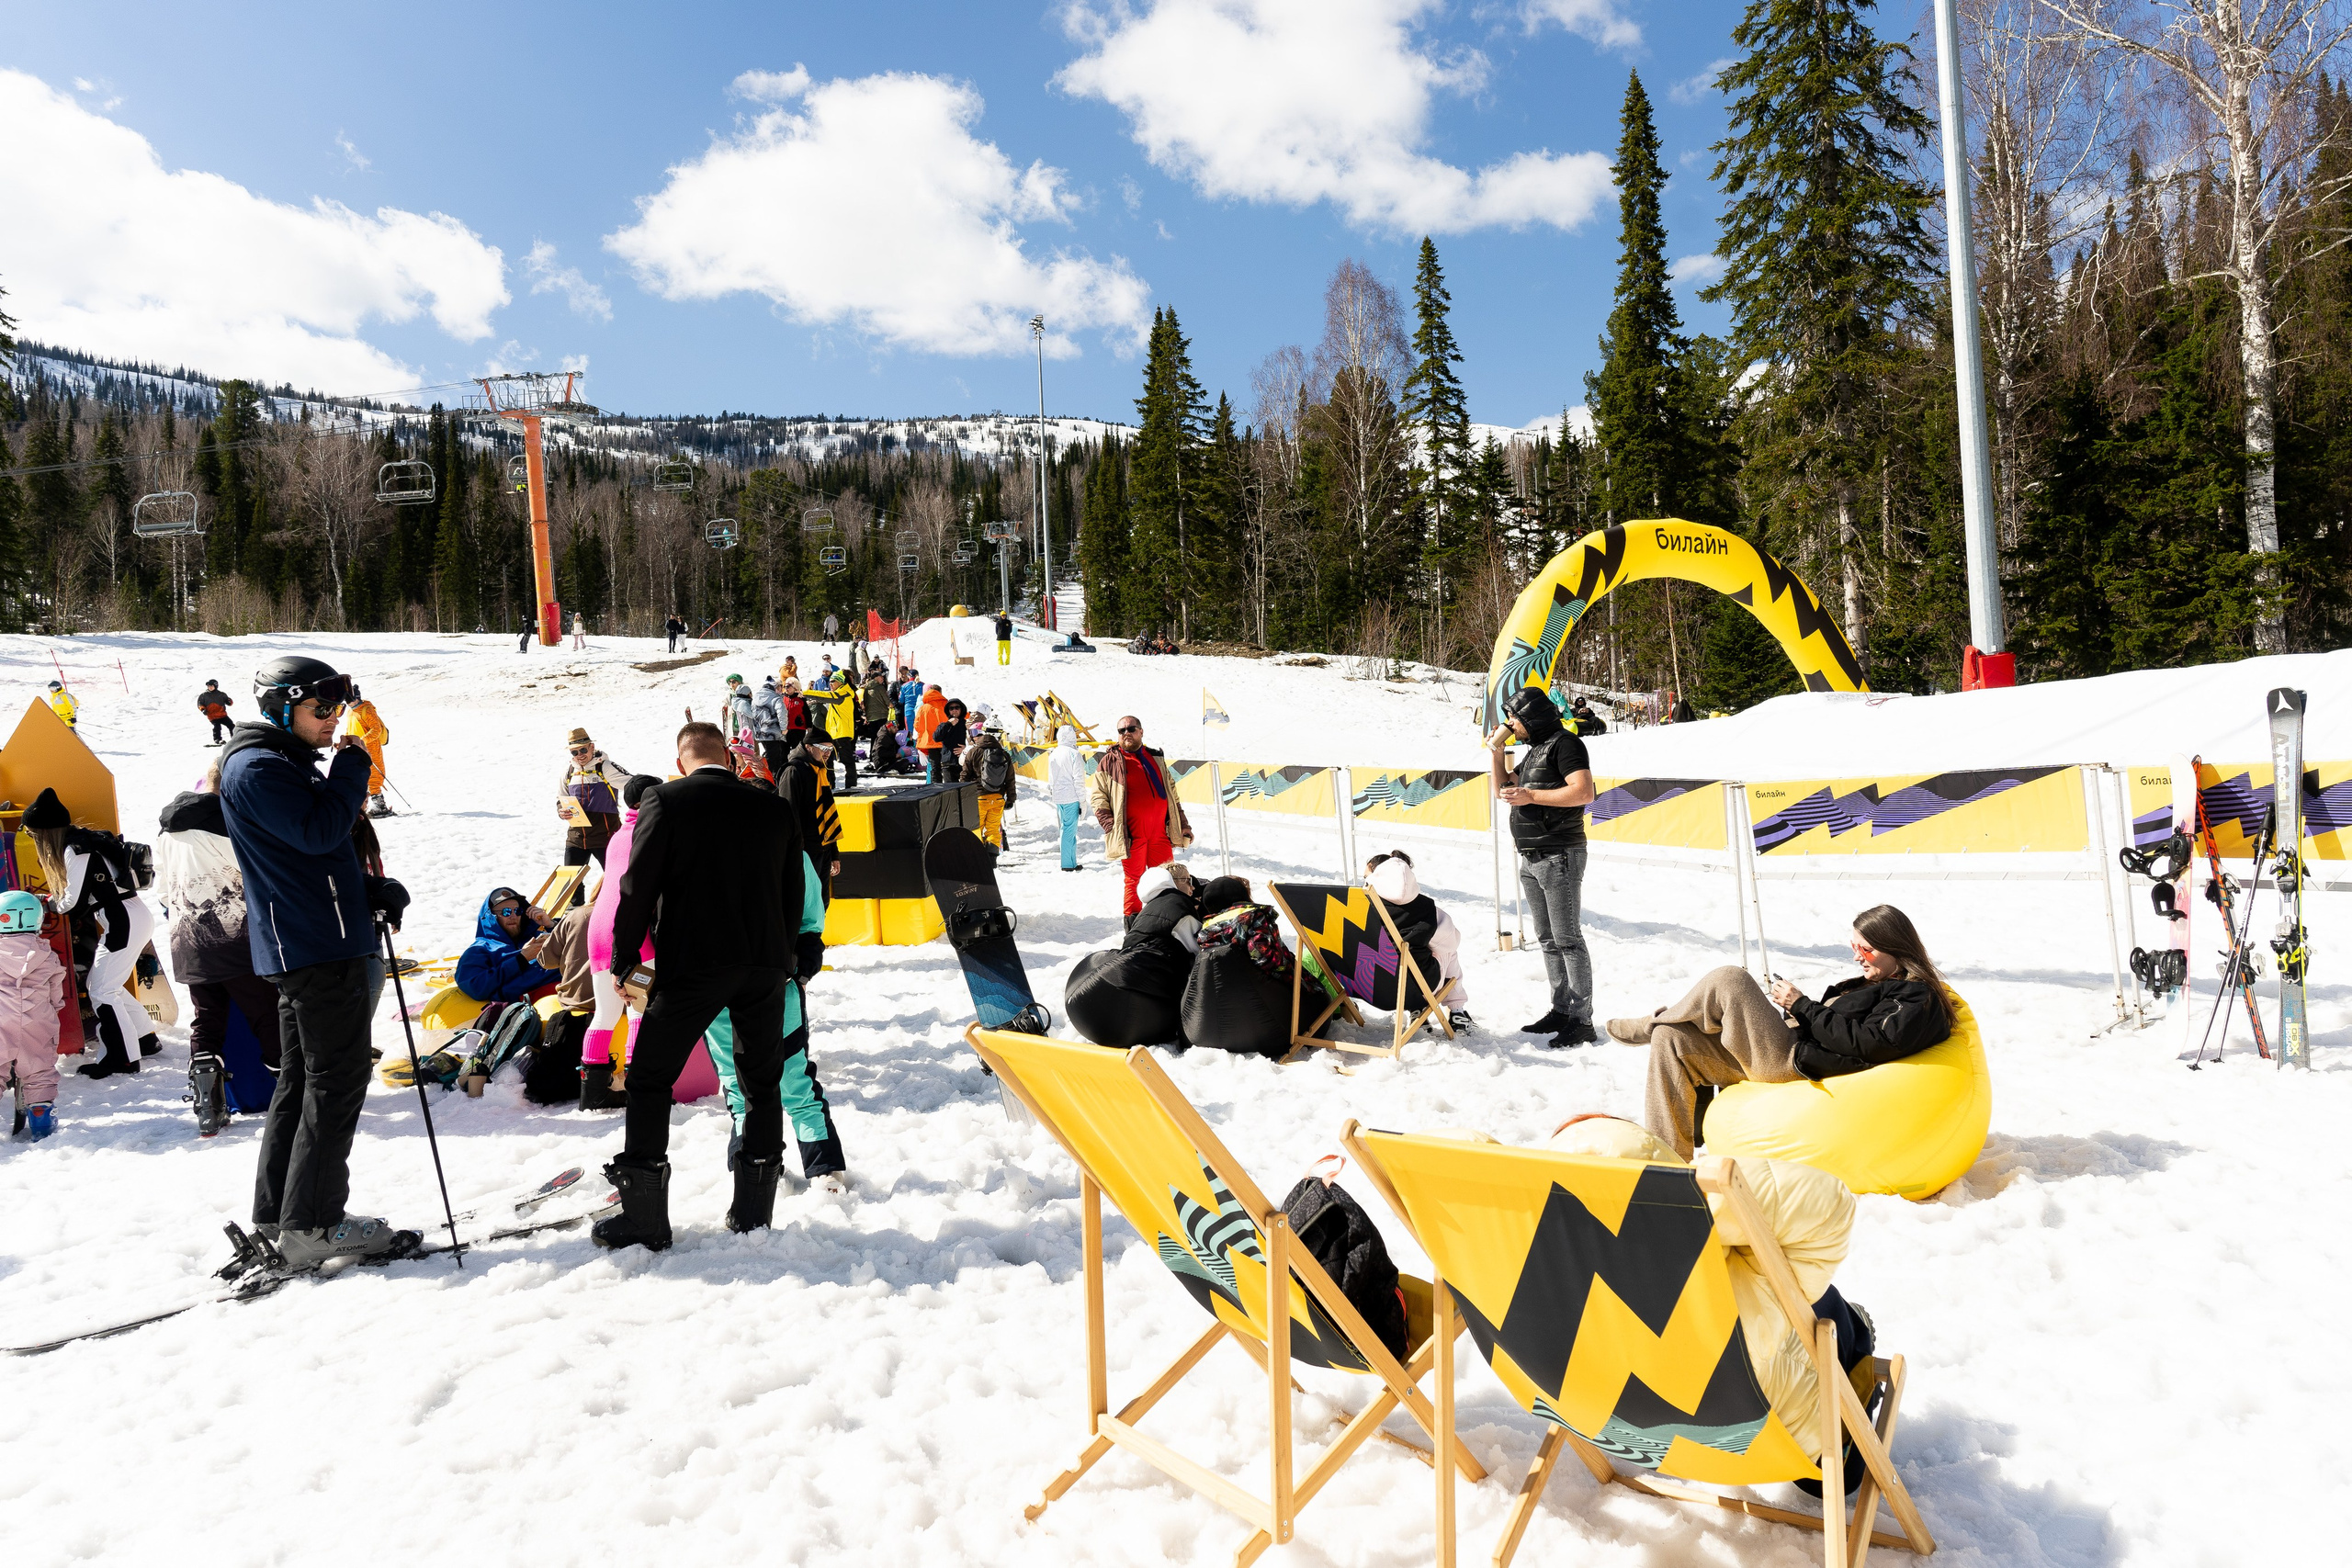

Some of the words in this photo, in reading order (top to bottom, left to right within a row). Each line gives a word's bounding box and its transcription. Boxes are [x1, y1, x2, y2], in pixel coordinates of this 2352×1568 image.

[1655, 527, 1728, 555] билайн
[1755, 790, 1786, 798] билайн
[334, 1243, 368, 1252] ATOMIC
